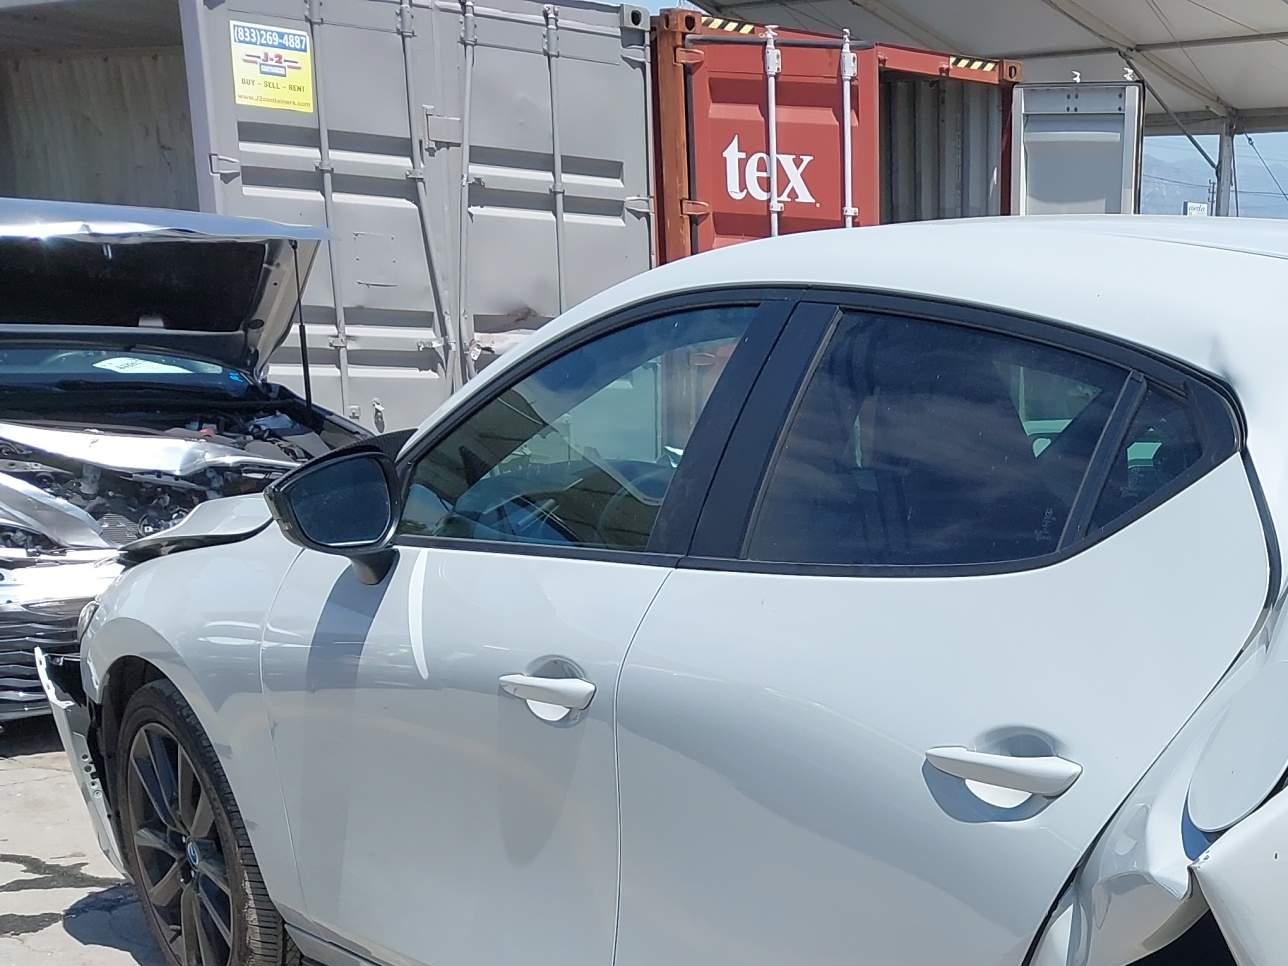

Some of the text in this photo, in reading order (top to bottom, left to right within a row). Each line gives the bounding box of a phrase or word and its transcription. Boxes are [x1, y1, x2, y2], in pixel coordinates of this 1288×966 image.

[234, 26, 306, 50] (833)269-4887
[262, 52, 283, 64] J-2
[241, 78, 255, 86] BUY
[264, 81, 280, 90] SELL
[289, 85, 305, 93] RENT
[722, 134, 816, 203] tex
